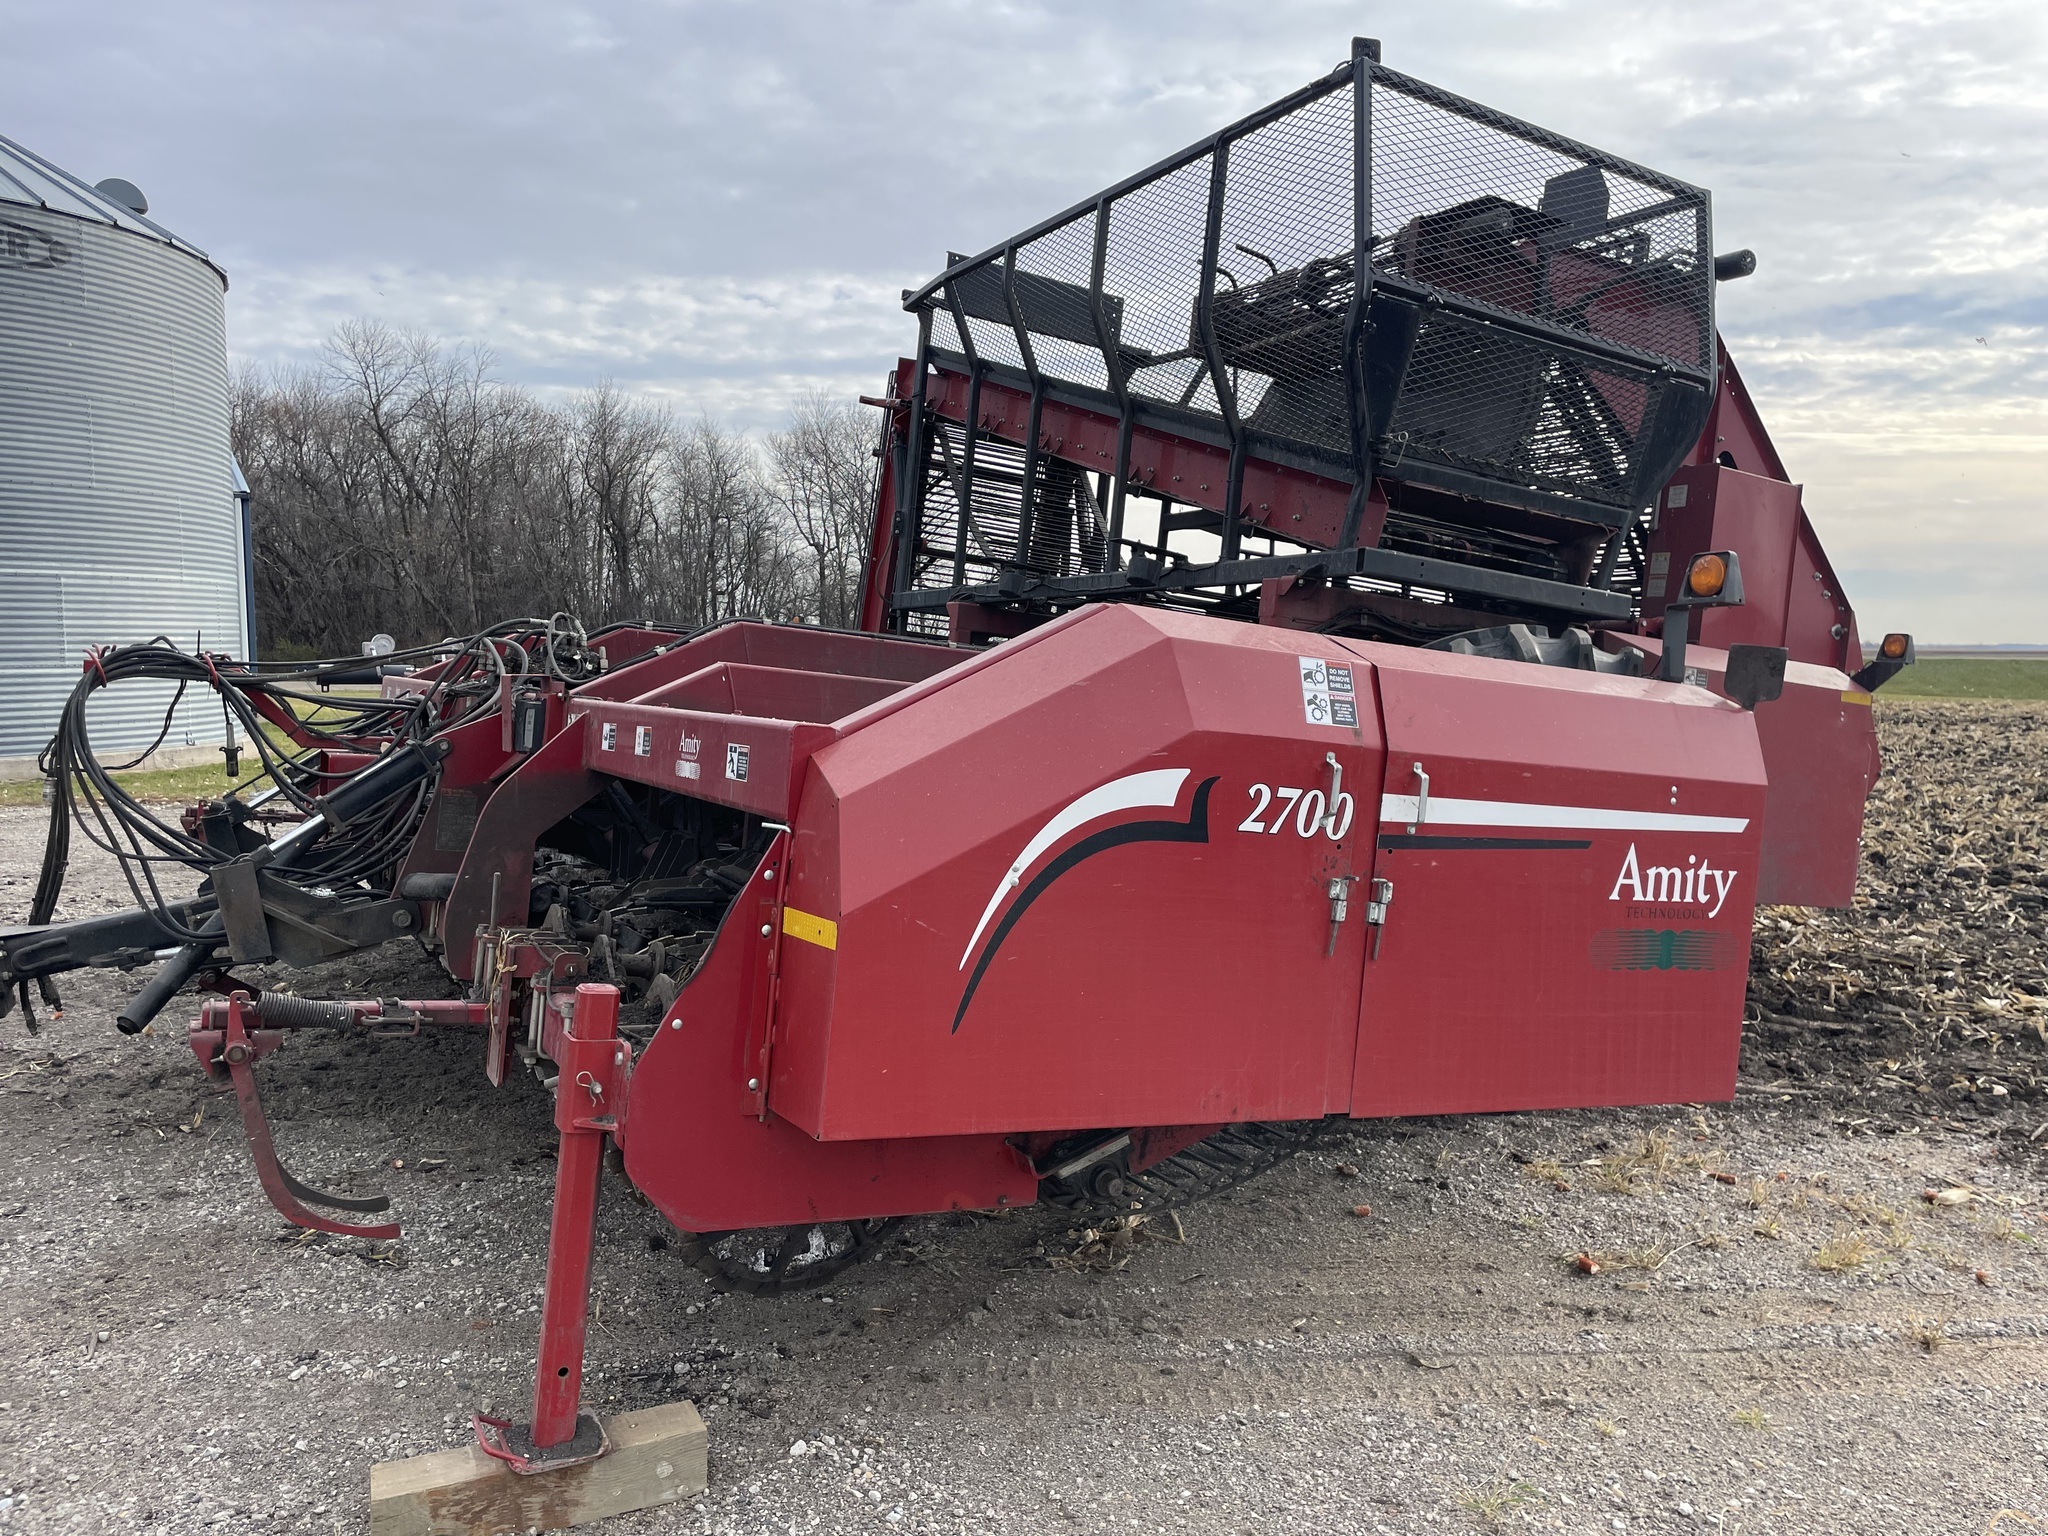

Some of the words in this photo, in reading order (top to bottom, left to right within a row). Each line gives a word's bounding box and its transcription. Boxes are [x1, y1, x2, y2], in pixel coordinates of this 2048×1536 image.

[1329, 675, 1350, 683] REMOVE
[1330, 682, 1351, 690] SHIELDS
[678, 729, 702, 760] Amity
[1238, 783, 1354, 841] 2700
[1609, 842, 1738, 919] Amity
[1626, 906, 1707, 920] TECHNOLOGY
